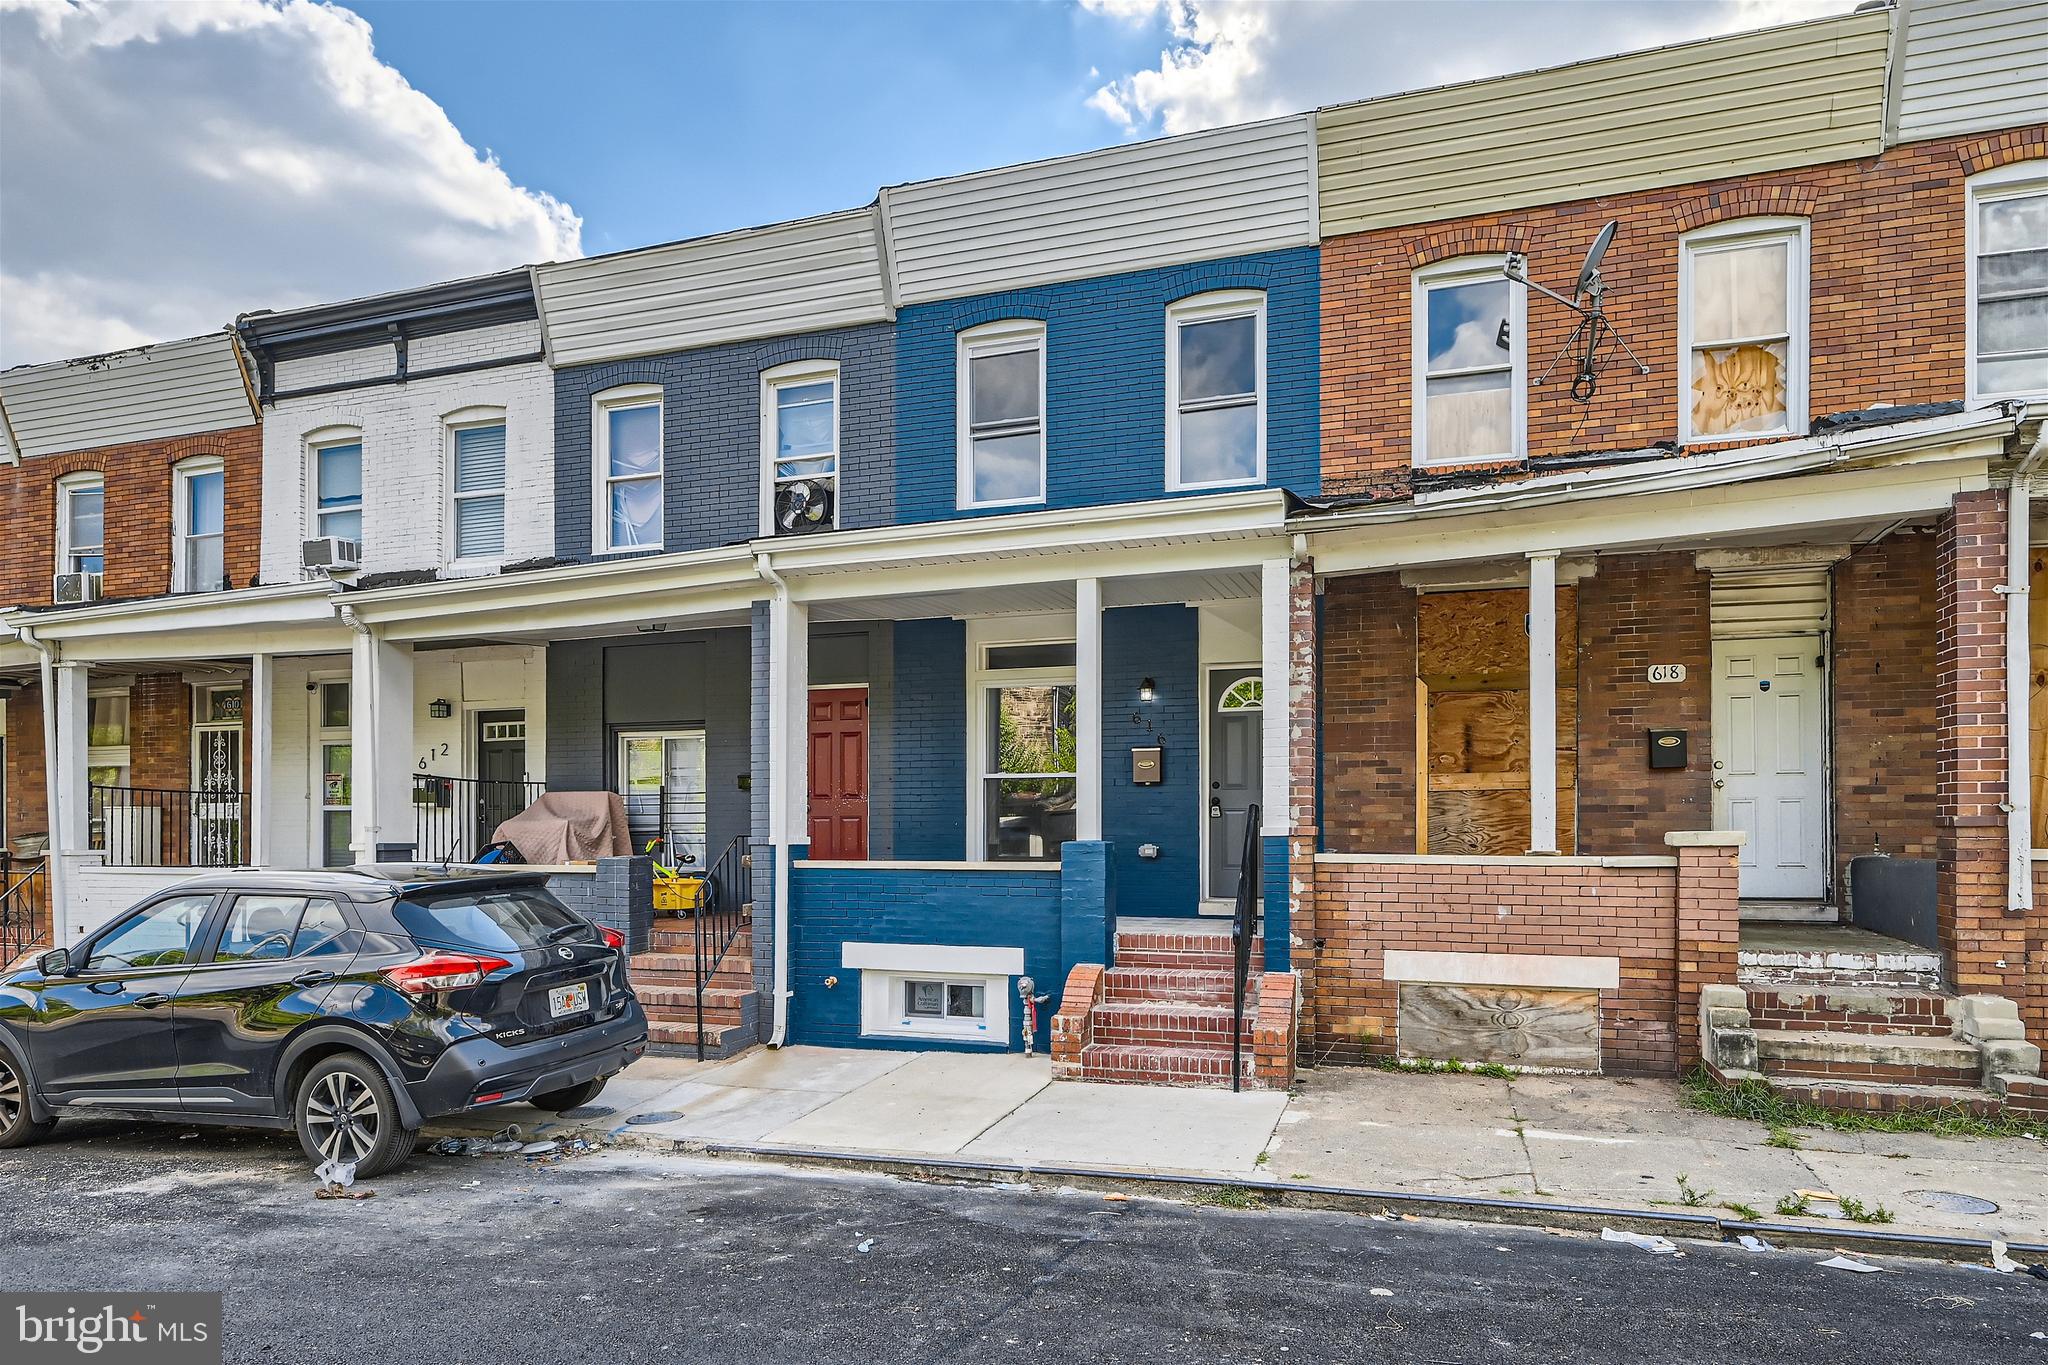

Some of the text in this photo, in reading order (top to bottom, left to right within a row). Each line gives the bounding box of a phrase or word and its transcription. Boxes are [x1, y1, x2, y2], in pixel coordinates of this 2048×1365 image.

[1653, 665, 1679, 681] 618
[1132, 712, 1166, 745] 616
[418, 742, 449, 770] 612
[495, 1028, 525, 1040] KICKS
